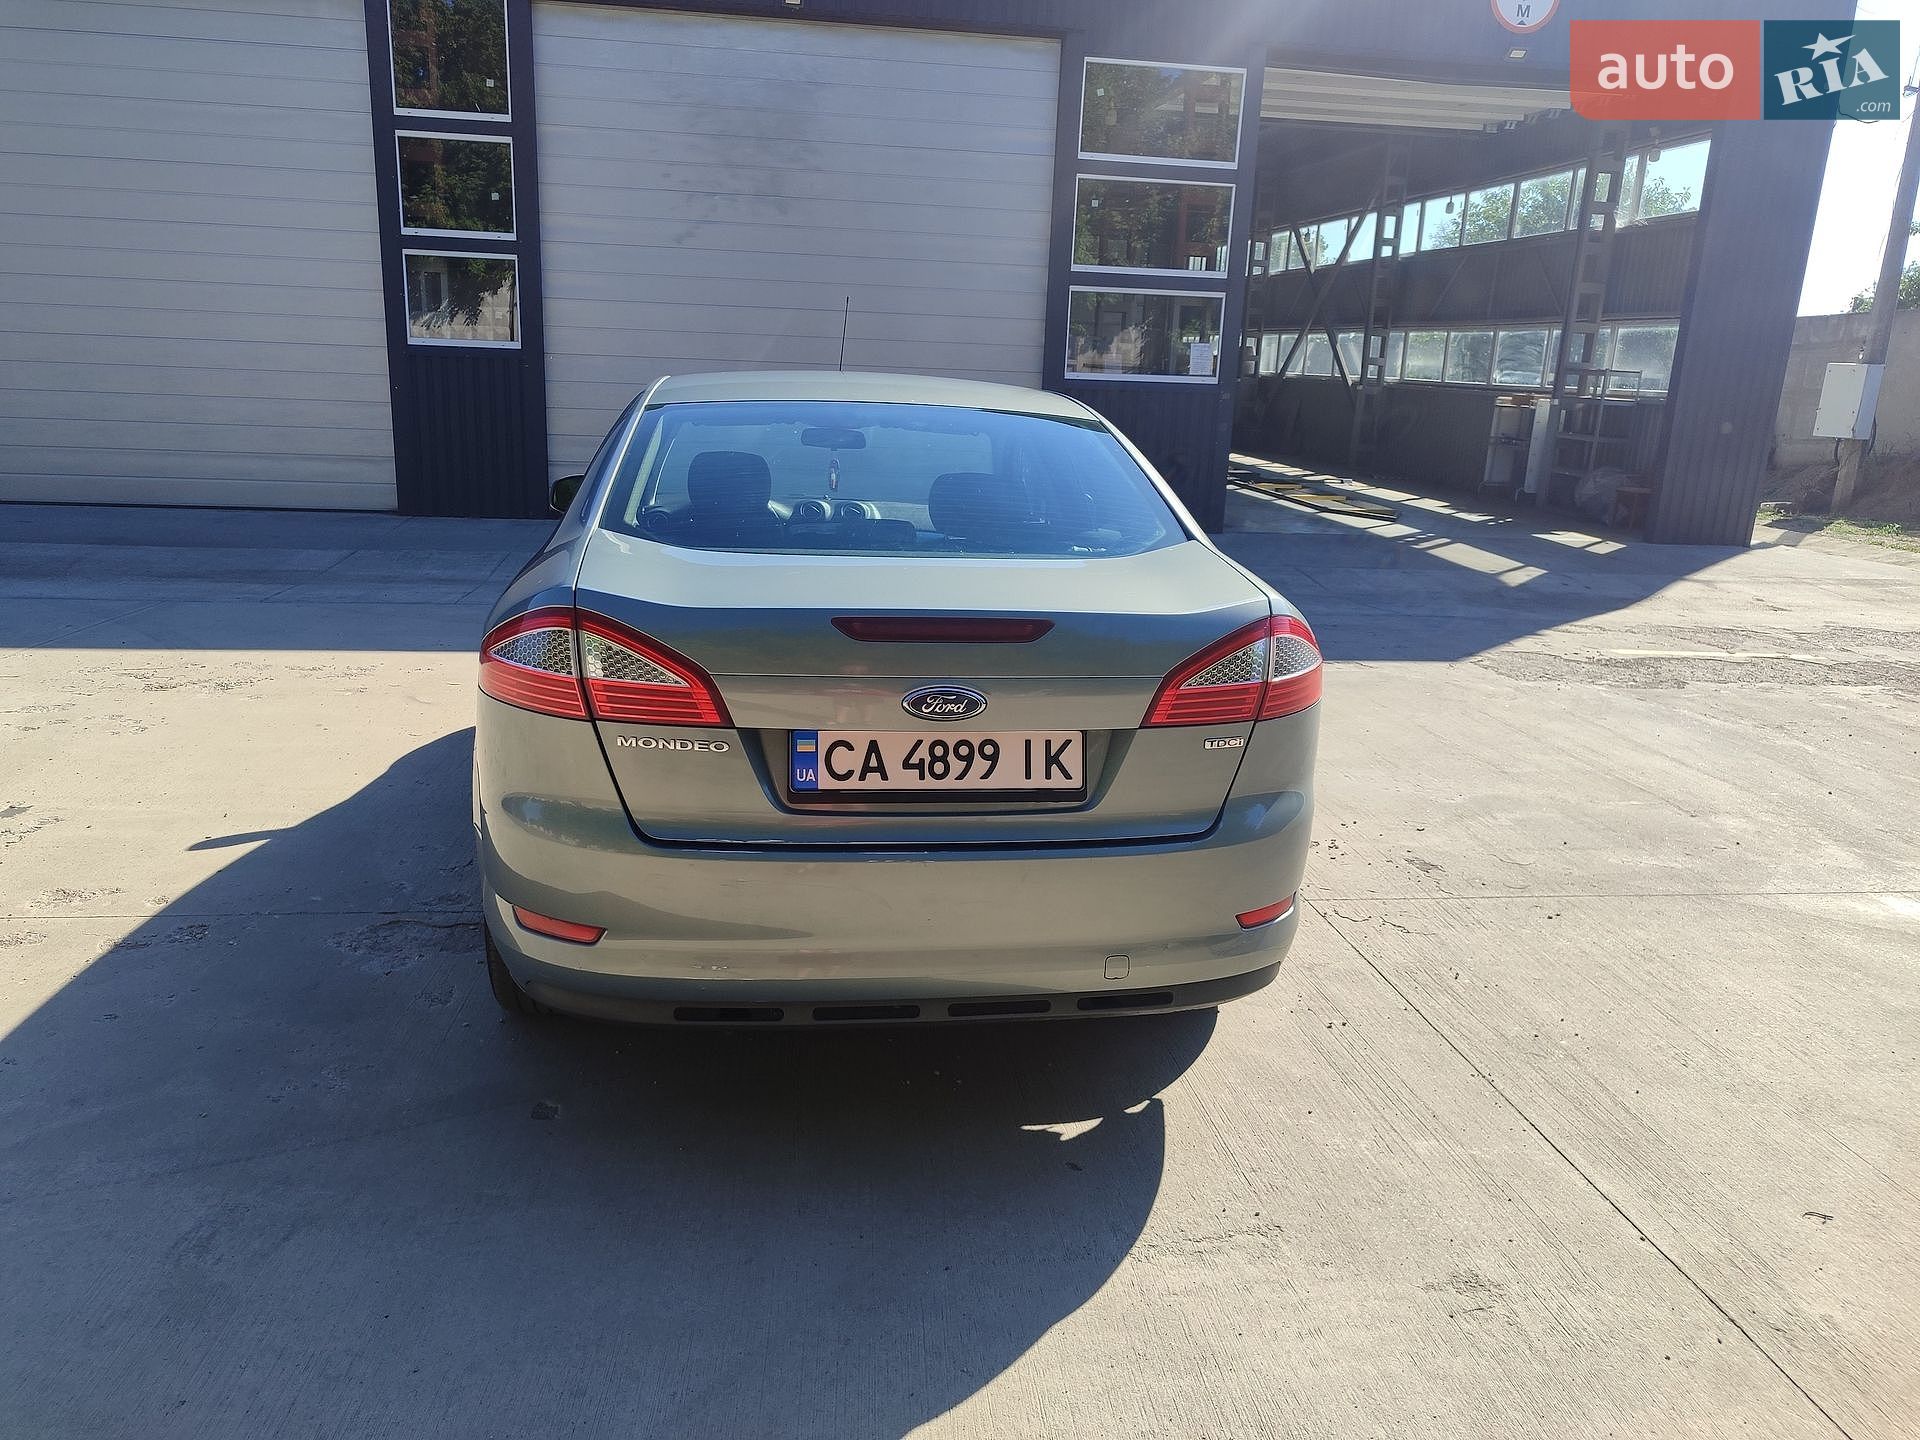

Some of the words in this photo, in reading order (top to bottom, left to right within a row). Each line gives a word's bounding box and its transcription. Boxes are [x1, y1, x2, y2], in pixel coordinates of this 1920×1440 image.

[921, 694, 968, 713] Ford
[616, 736, 731, 753] MONDEO
[824, 739, 890, 782] CA
[901, 738, 1001, 781] 4899
[1023, 738, 1074, 781] IK
[796, 768, 817, 782] UA
